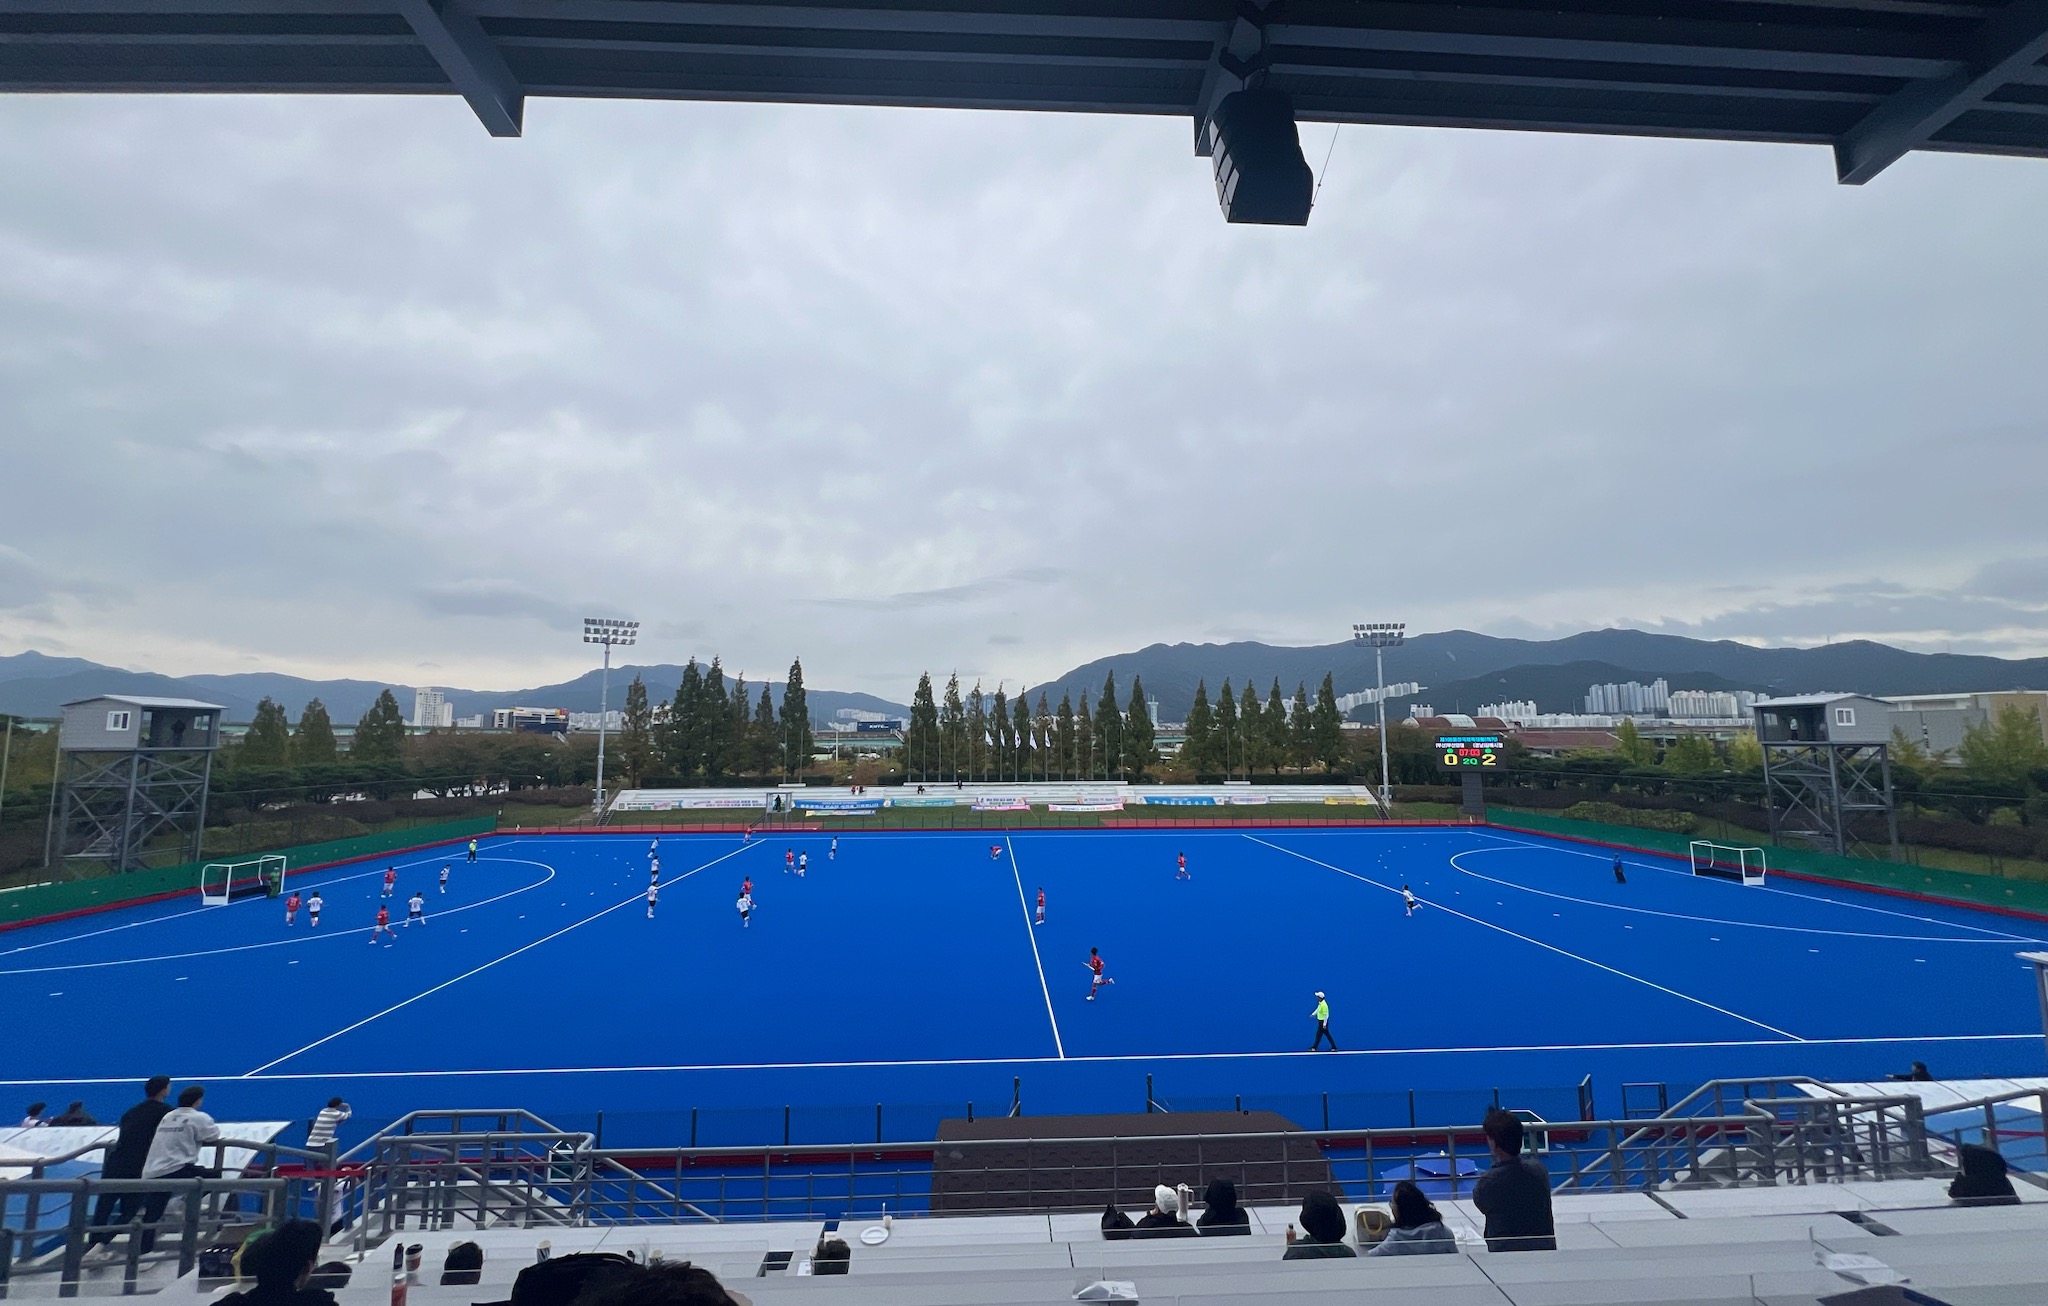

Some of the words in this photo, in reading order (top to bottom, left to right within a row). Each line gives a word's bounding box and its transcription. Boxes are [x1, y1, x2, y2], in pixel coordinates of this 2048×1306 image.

[1459, 748, 1480, 756] 07:03
[1444, 754, 1458, 765] 0
[1482, 754, 1496, 765] 2
